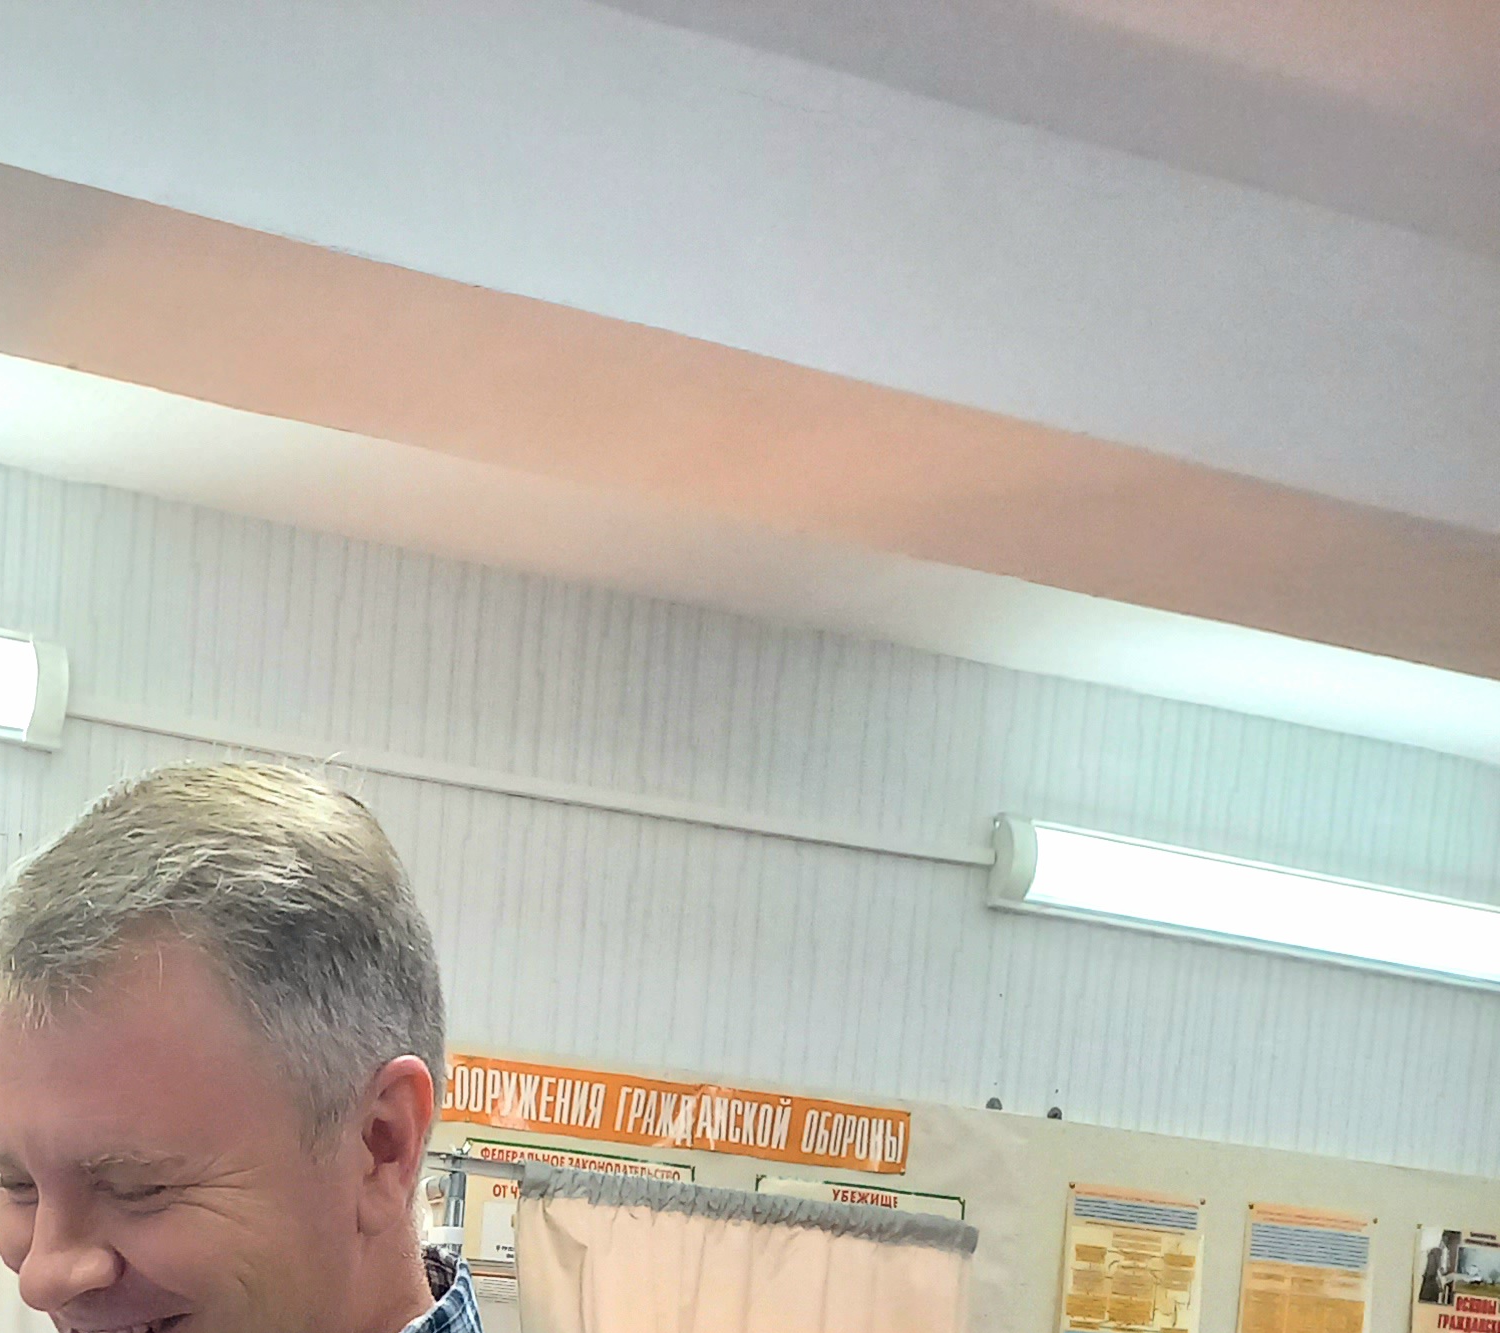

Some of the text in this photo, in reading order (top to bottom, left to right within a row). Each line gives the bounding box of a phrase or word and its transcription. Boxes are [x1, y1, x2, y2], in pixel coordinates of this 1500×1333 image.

[614, 1086, 792, 1150] ГРАЖДАНСКОЙ
[801, 1109, 905, 1164] ОБОРОНЫ
[493, 1184, 508, 1198] ОТ
[832, 1188, 898, 1209] УБЕЖИЩЕ
